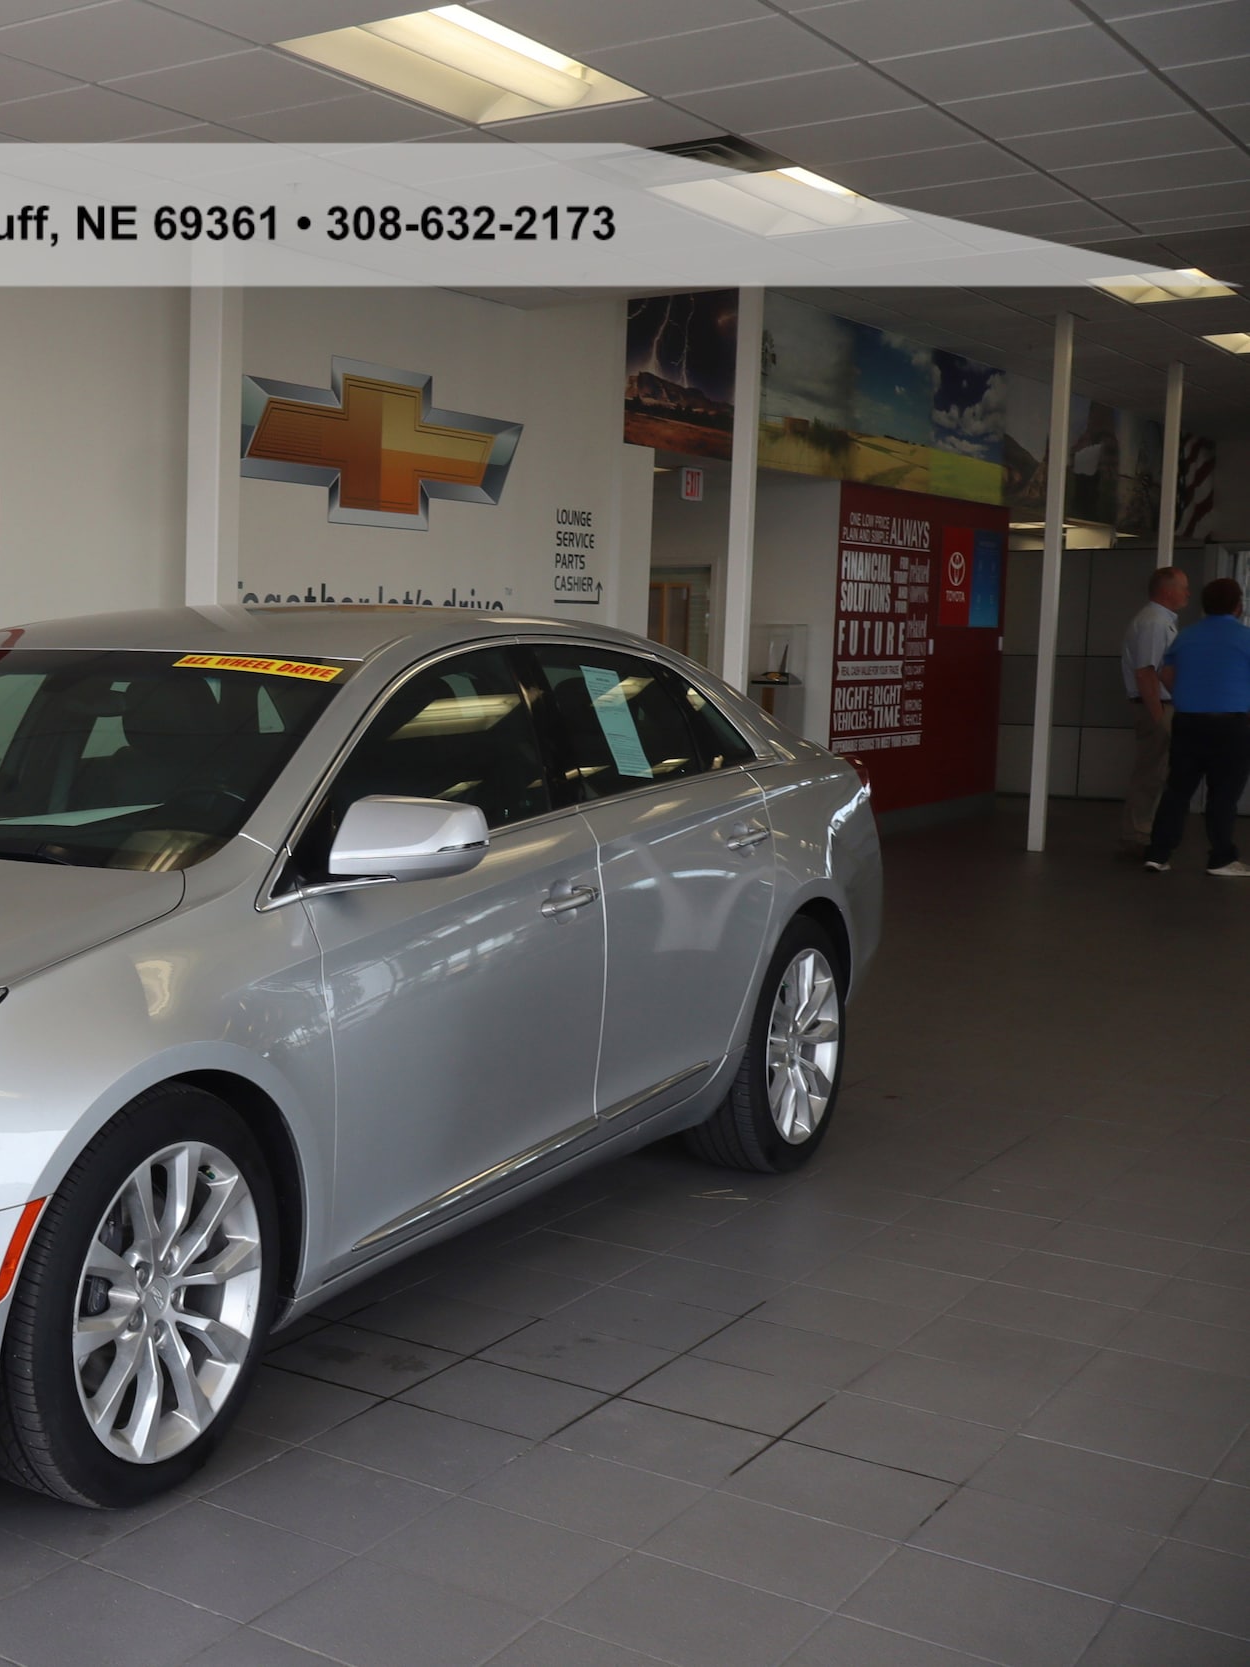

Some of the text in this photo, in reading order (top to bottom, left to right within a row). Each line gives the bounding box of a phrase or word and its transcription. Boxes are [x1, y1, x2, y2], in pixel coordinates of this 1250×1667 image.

[686, 470, 701, 496] EXIT
[556, 508, 593, 528] LOUNGE
[555, 530, 595, 550] SERVICE
[891, 517, 930, 548] ALWAYS
[554, 552, 586, 571] PARTS
[842, 550, 891, 583] FINANCIAL
[554, 575, 594, 593] CASHIER
[946, 590, 965, 602] TOYOTA
[840, 582, 891, 613] SOLUTIONS
[838, 620, 905, 656] FUTURE
[179, 657, 337, 678] ALL WHEEL DRIVE
[834, 686, 869, 711] RIGHT
[874, 684, 902, 705] RIGHT
[833, 711, 868, 732] VEHICLES
[872, 705, 901, 729] TIME
